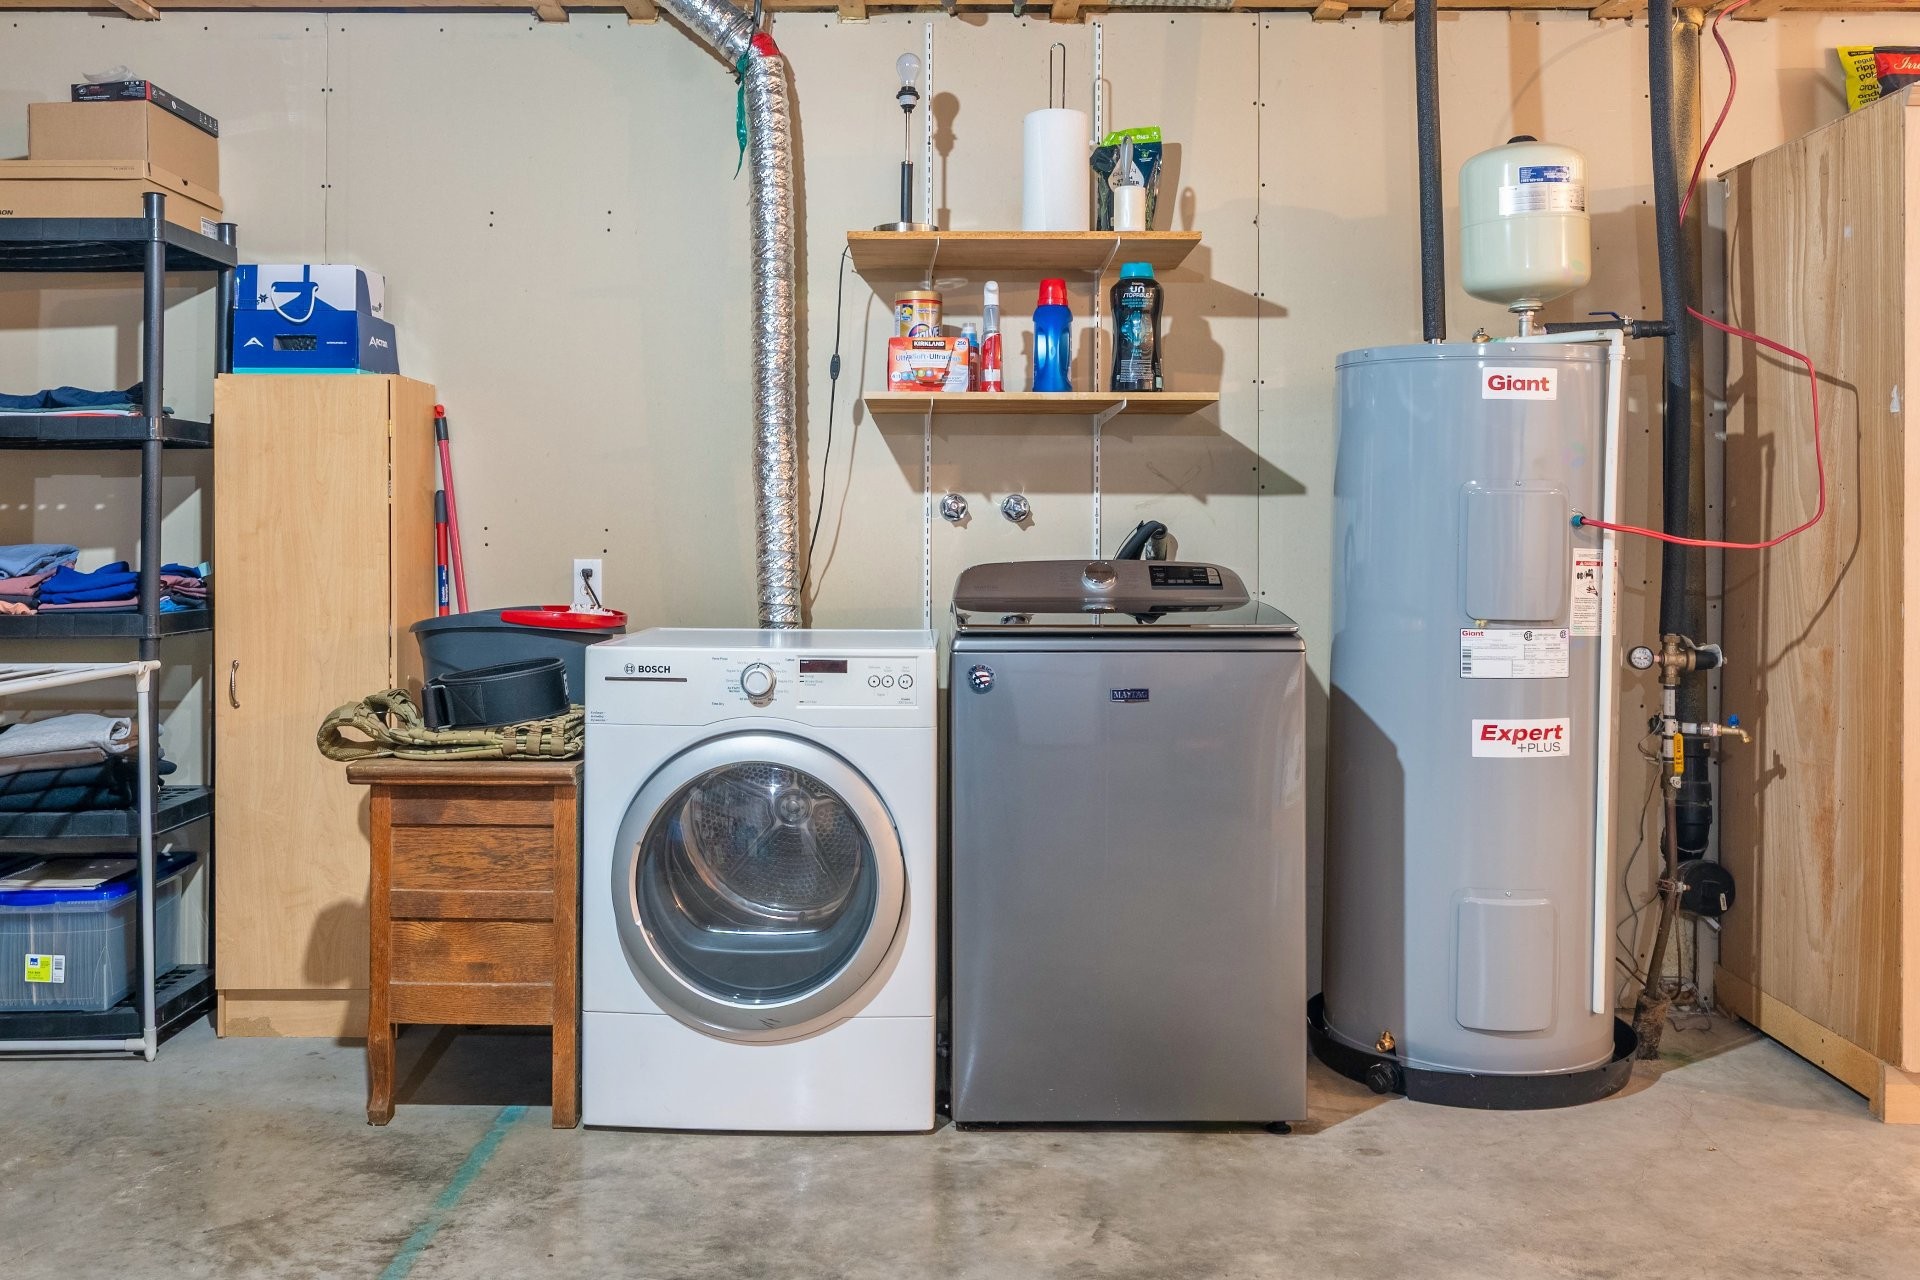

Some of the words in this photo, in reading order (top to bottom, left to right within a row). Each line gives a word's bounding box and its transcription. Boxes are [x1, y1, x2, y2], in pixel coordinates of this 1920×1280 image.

[1856, 64, 1876, 72] ripp
[1487, 374, 1550, 392] Giant
[638, 665, 671, 674] BOSCH
[1113, 691, 1147, 699] MAYTAG
[1480, 724, 1564, 745] Expert
[1517, 741, 1561, 753] +PLUS
